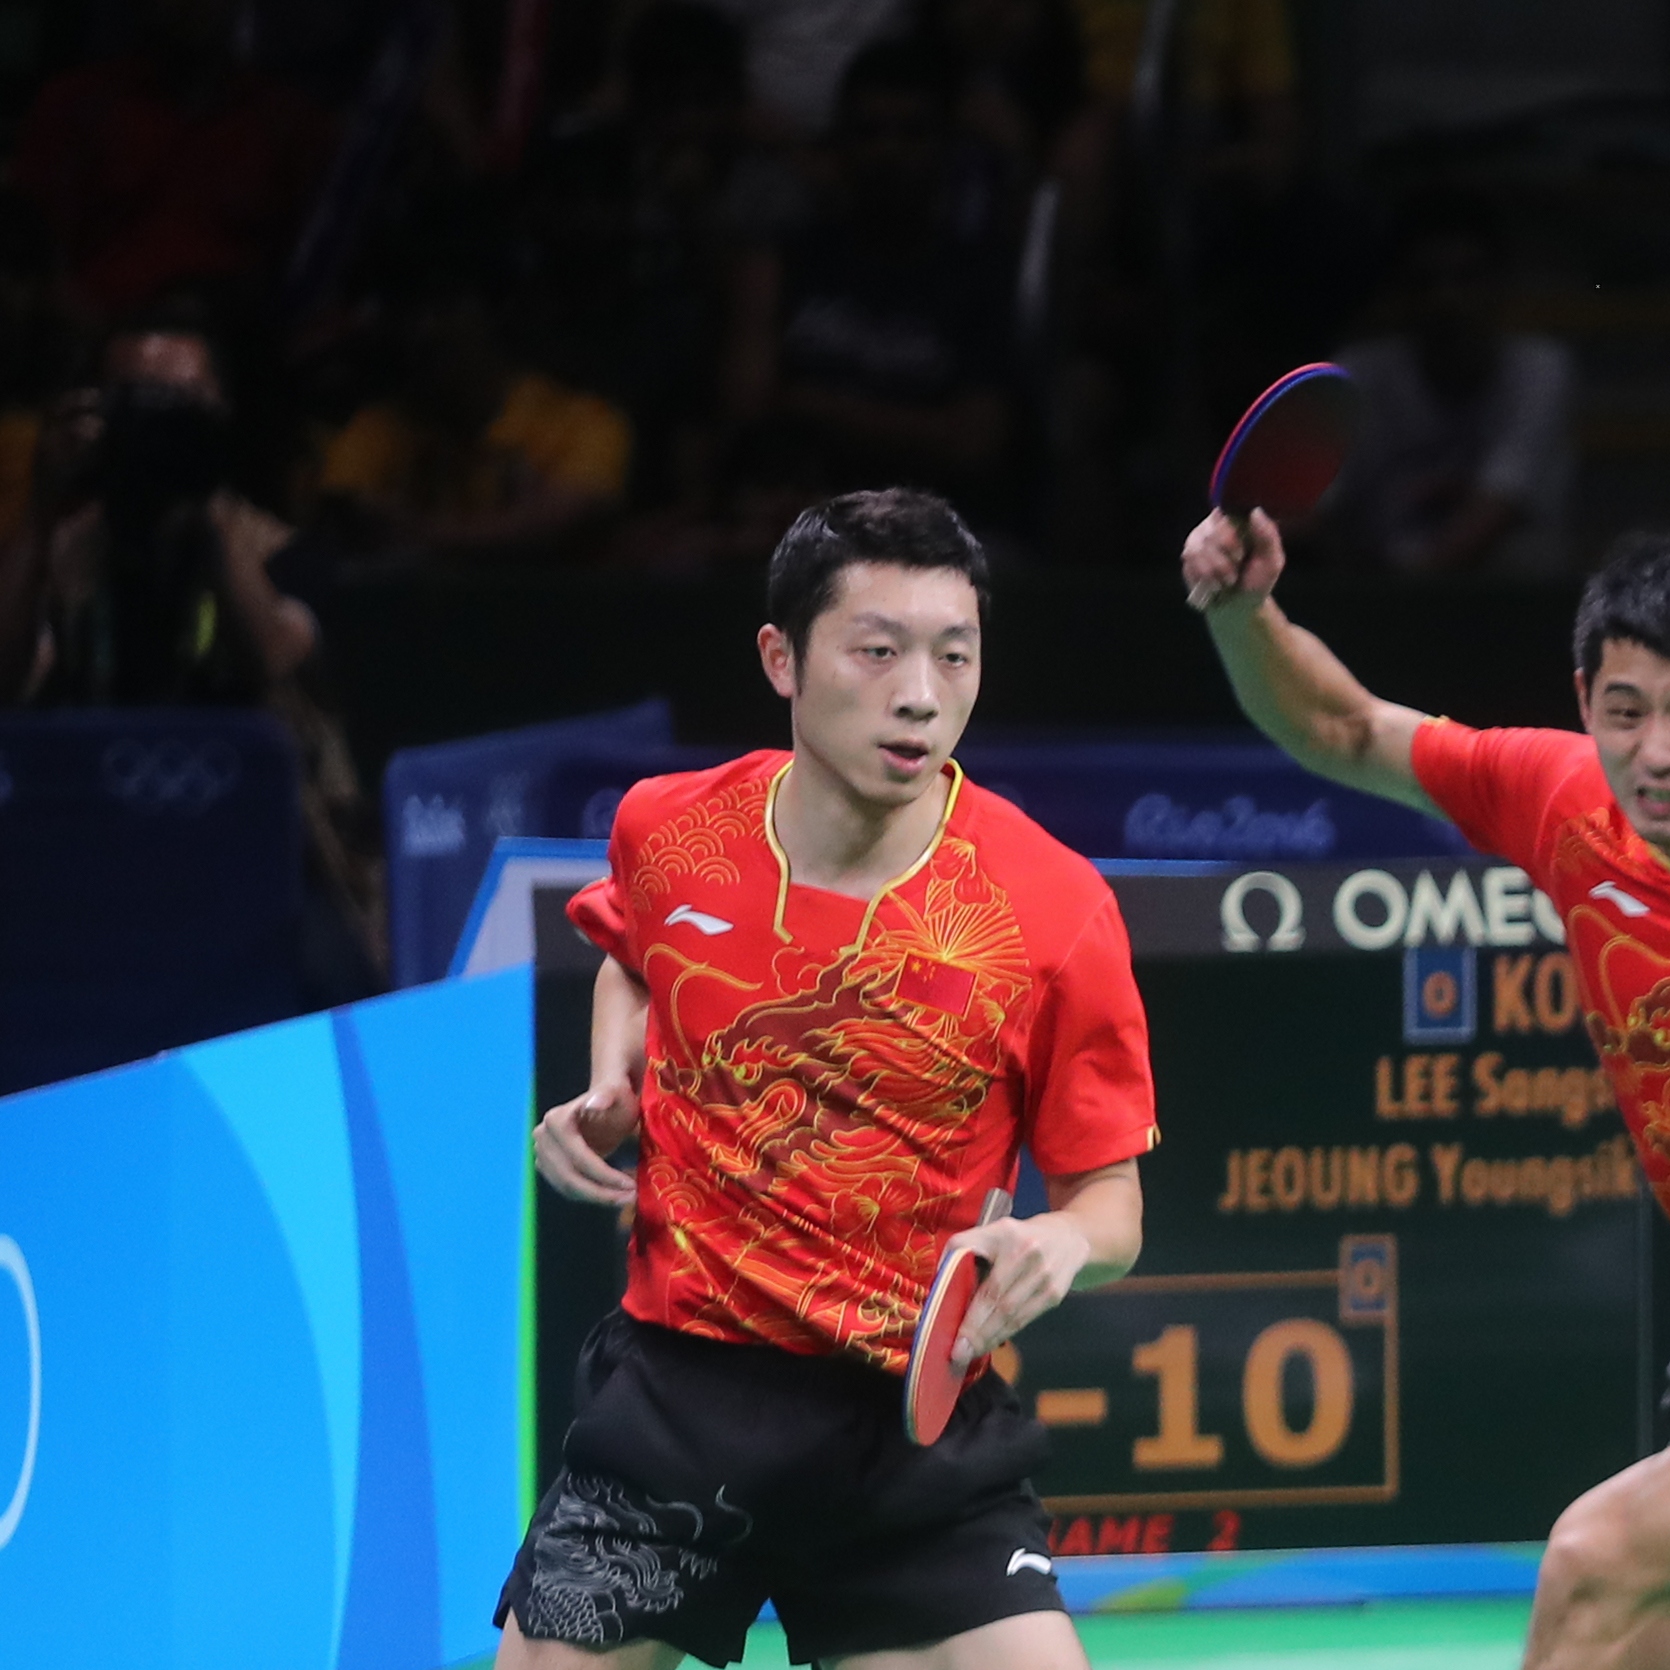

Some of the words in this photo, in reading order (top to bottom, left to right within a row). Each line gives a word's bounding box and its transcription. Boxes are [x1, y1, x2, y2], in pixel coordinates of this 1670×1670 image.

[1374, 1054, 1461, 1121] LEE
[1219, 1146, 1418, 1212] JEOUNG
[1047, 1512, 1174, 1555] AME
